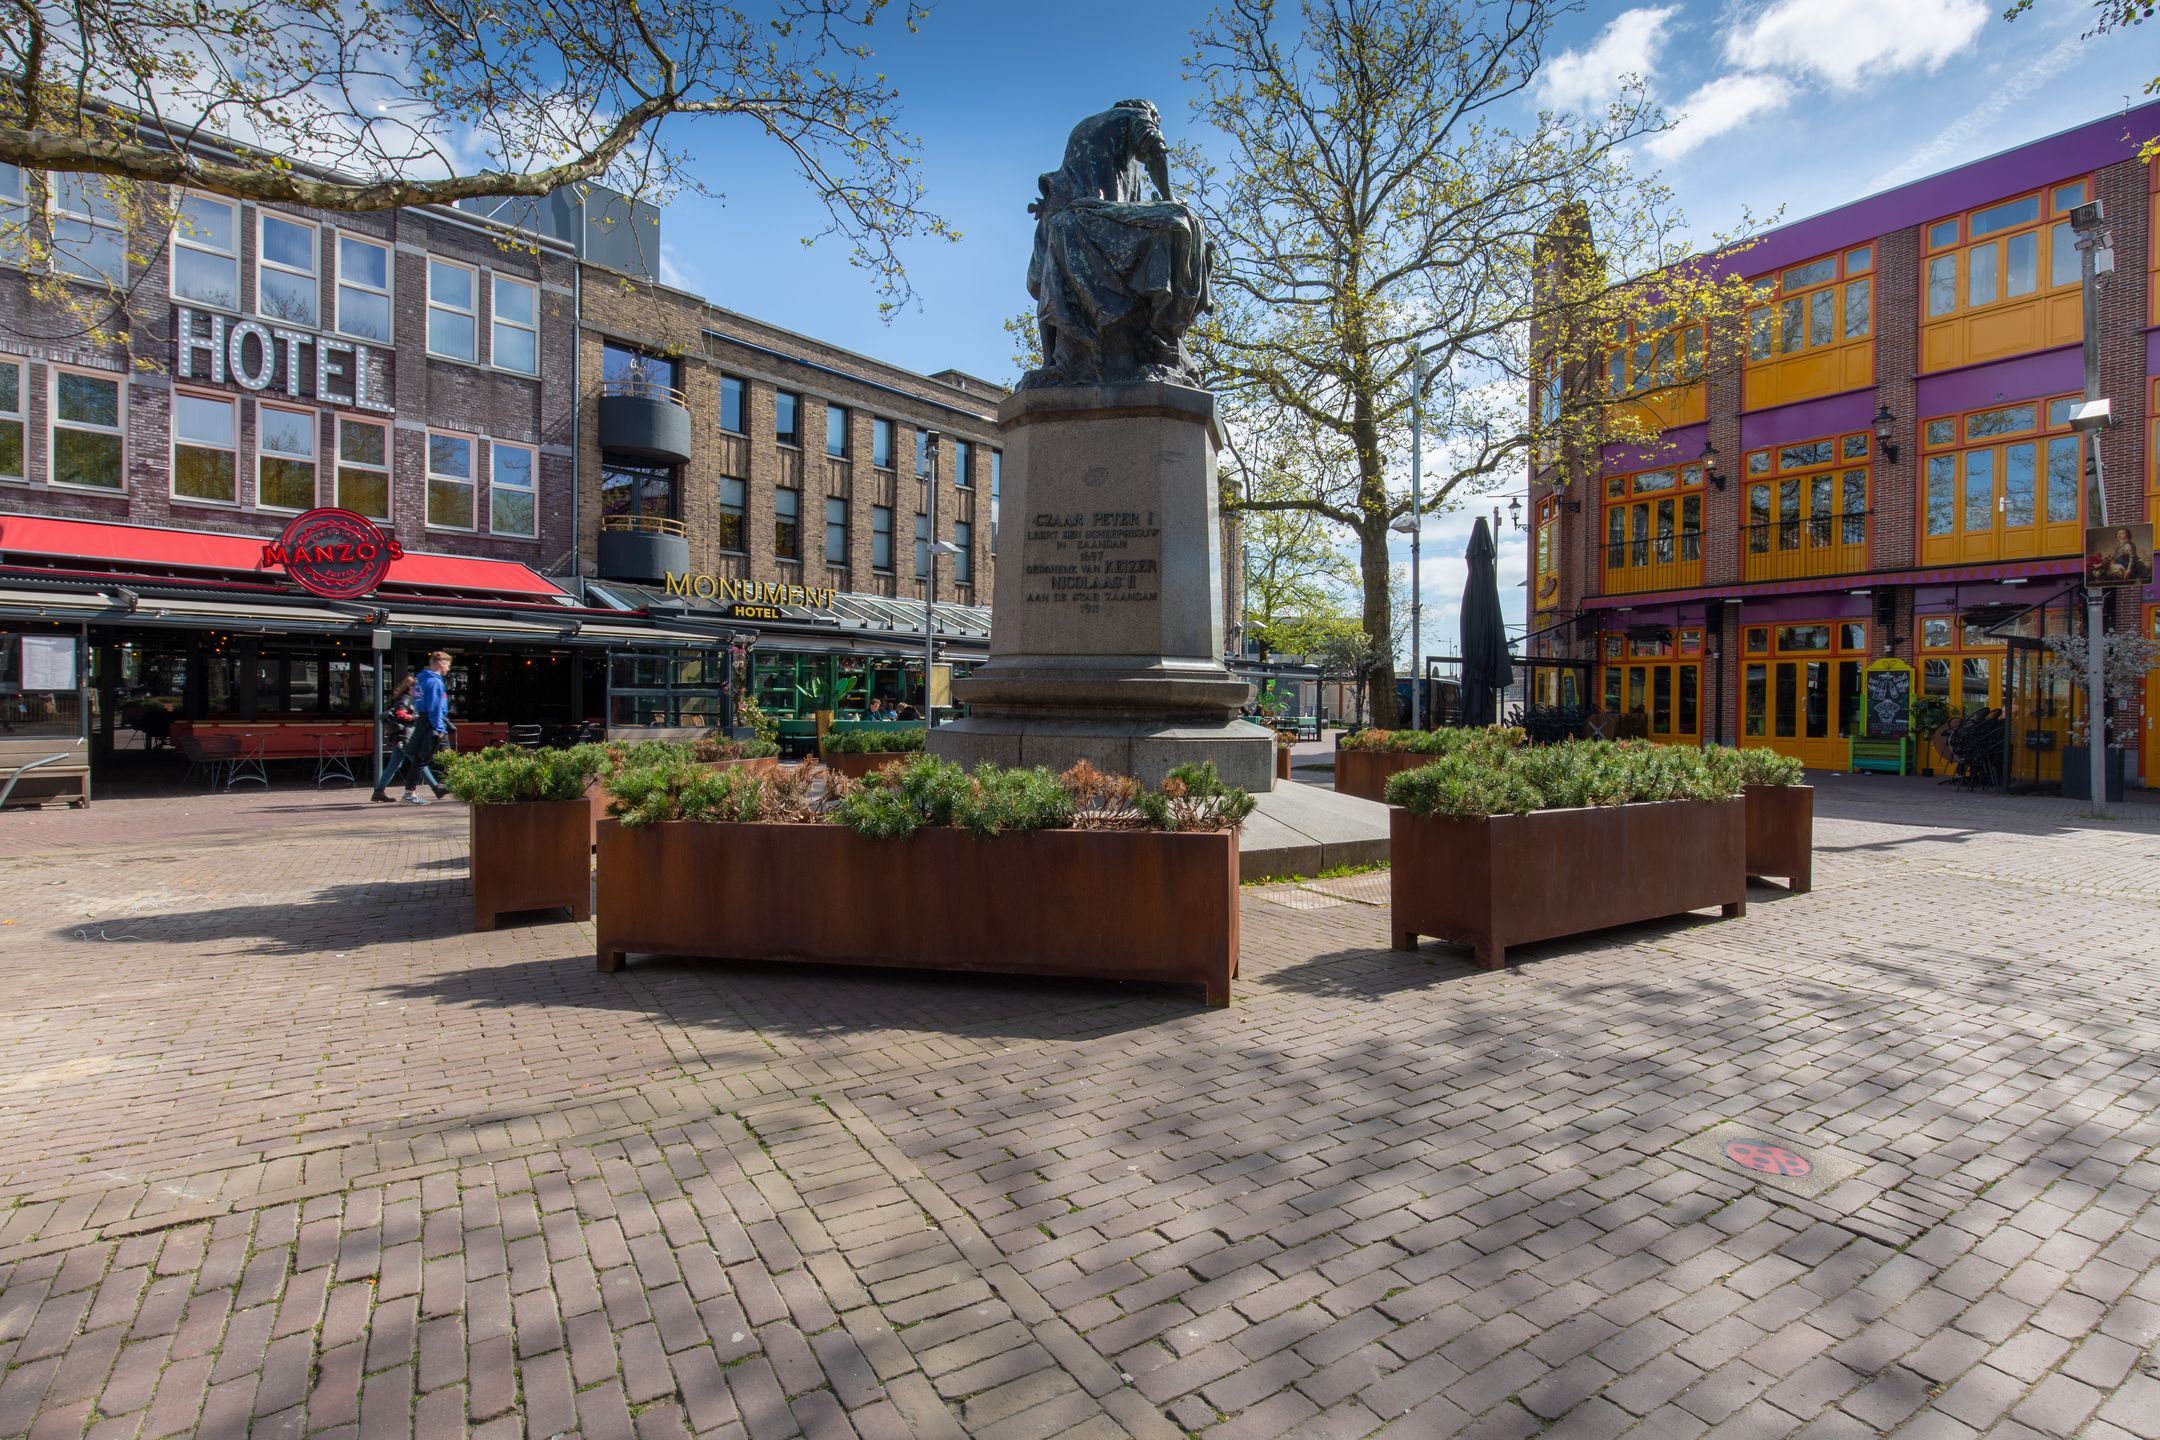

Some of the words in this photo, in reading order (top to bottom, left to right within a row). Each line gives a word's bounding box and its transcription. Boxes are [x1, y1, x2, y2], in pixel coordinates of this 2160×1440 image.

[178, 307, 395, 412] HOTEL
[1035, 513, 1084, 527] CZAAR
[1093, 512, 1140, 527] PETER
[262, 540, 404, 567] MANZO'S
[1080, 551, 1105, 561] 1697
[1080, 565, 1100, 574] VAN
[1104, 560, 1157, 574] KEIZER
[664, 571, 837, 609] MONUMENT
[1052, 576, 1121, 590] NICOLAAS
[1127, 575, 1136, 589] II
[1027, 593, 1049, 602] AAN
[735, 606, 779, 619] HOTEL
